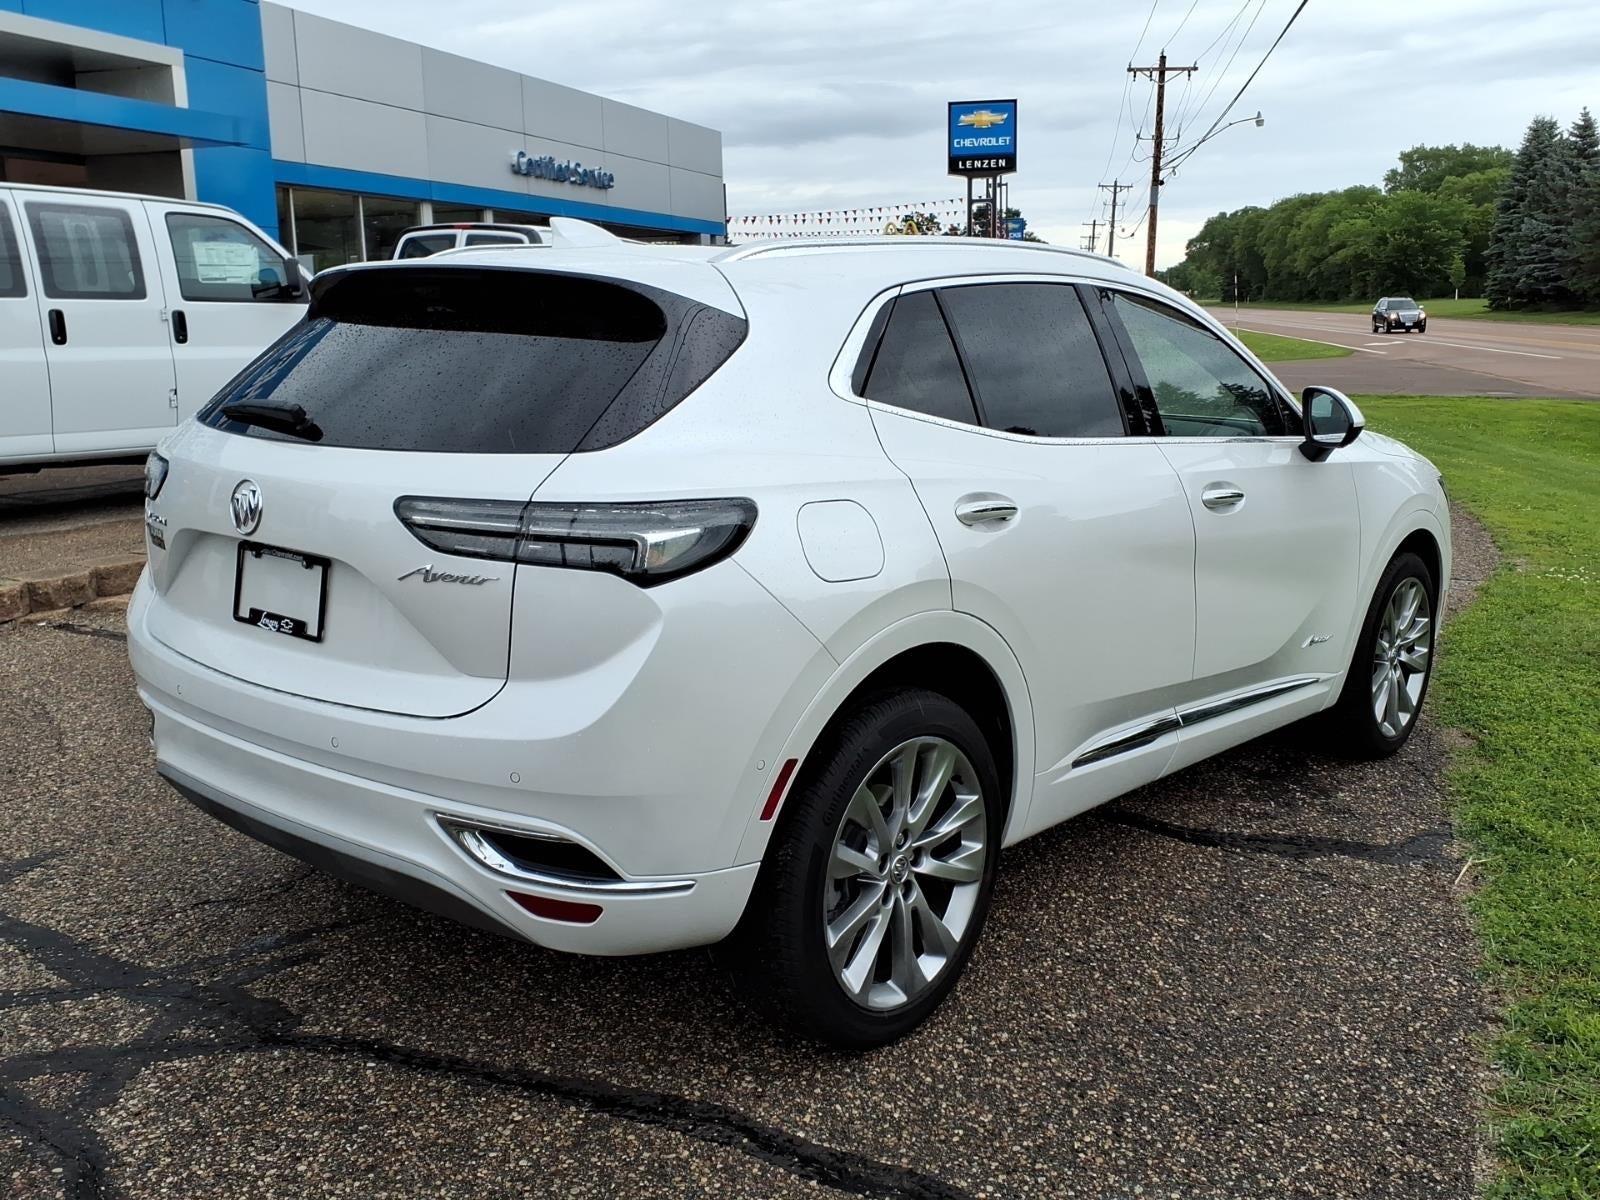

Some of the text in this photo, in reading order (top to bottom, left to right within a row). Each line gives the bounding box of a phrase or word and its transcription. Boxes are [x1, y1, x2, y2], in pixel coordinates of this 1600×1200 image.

[953, 136, 1011, 148] CHEVROLET
[510, 151, 614, 189] Certified Service
[958, 159, 1006, 169] LENZEN
[397, 563, 500, 586] Avenir
